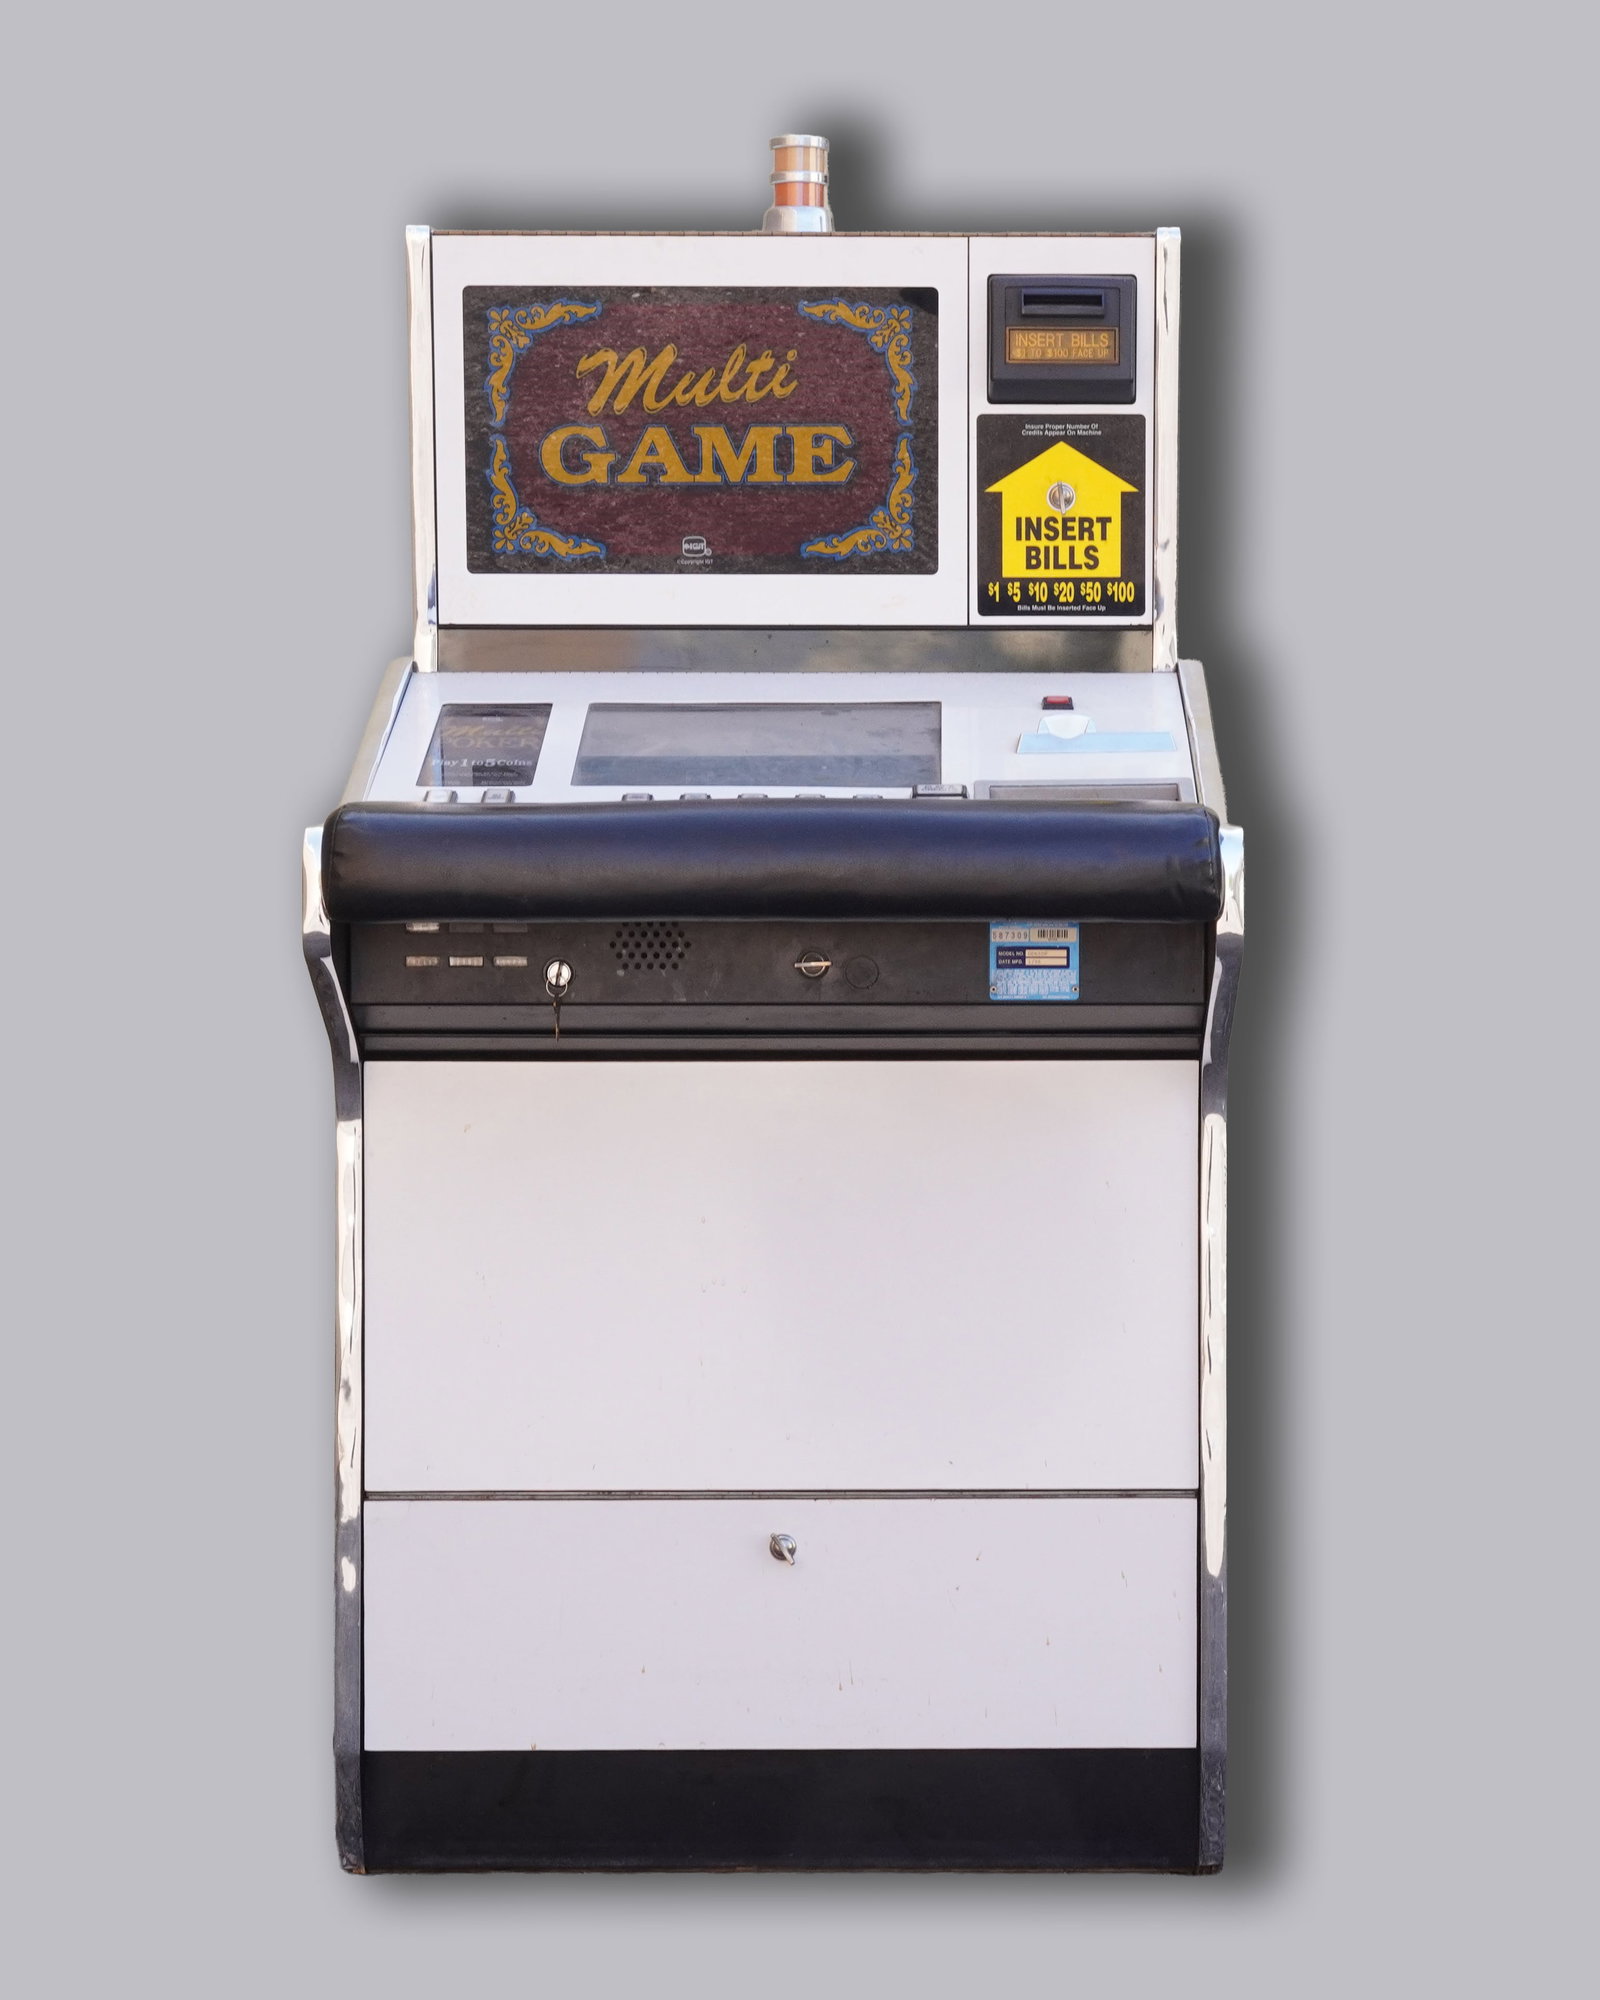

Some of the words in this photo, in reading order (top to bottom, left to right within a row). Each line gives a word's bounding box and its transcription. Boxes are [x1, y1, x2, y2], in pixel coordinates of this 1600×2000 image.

[1015, 333, 1064, 347] INSERT
[1071, 333, 1108, 347] BILLS
[1031, 348, 1042, 358] TO
[1047, 348, 1068, 358] $100
[1072, 348, 1093, 358] FACE
[1098, 348, 1109, 358] UP
[576, 343, 798, 417] Multi
[1044, 429, 1065, 437] Appear
[1045, 423, 1065, 431] Proper
[539, 424, 857, 485] GAME
[1015, 516, 1112, 541] INSERT
[1025, 546, 1100, 570] BILLS
[988, 581, 1000, 603] $1
[1007, 581, 1021, 603] $5
[1028, 581, 1048, 603] $10
[1053, 581, 1075, 603] $20
[1080, 581, 1102, 603] $50
[1106, 581, 1135, 603] $100
[1097, 604, 1106, 612] Up
